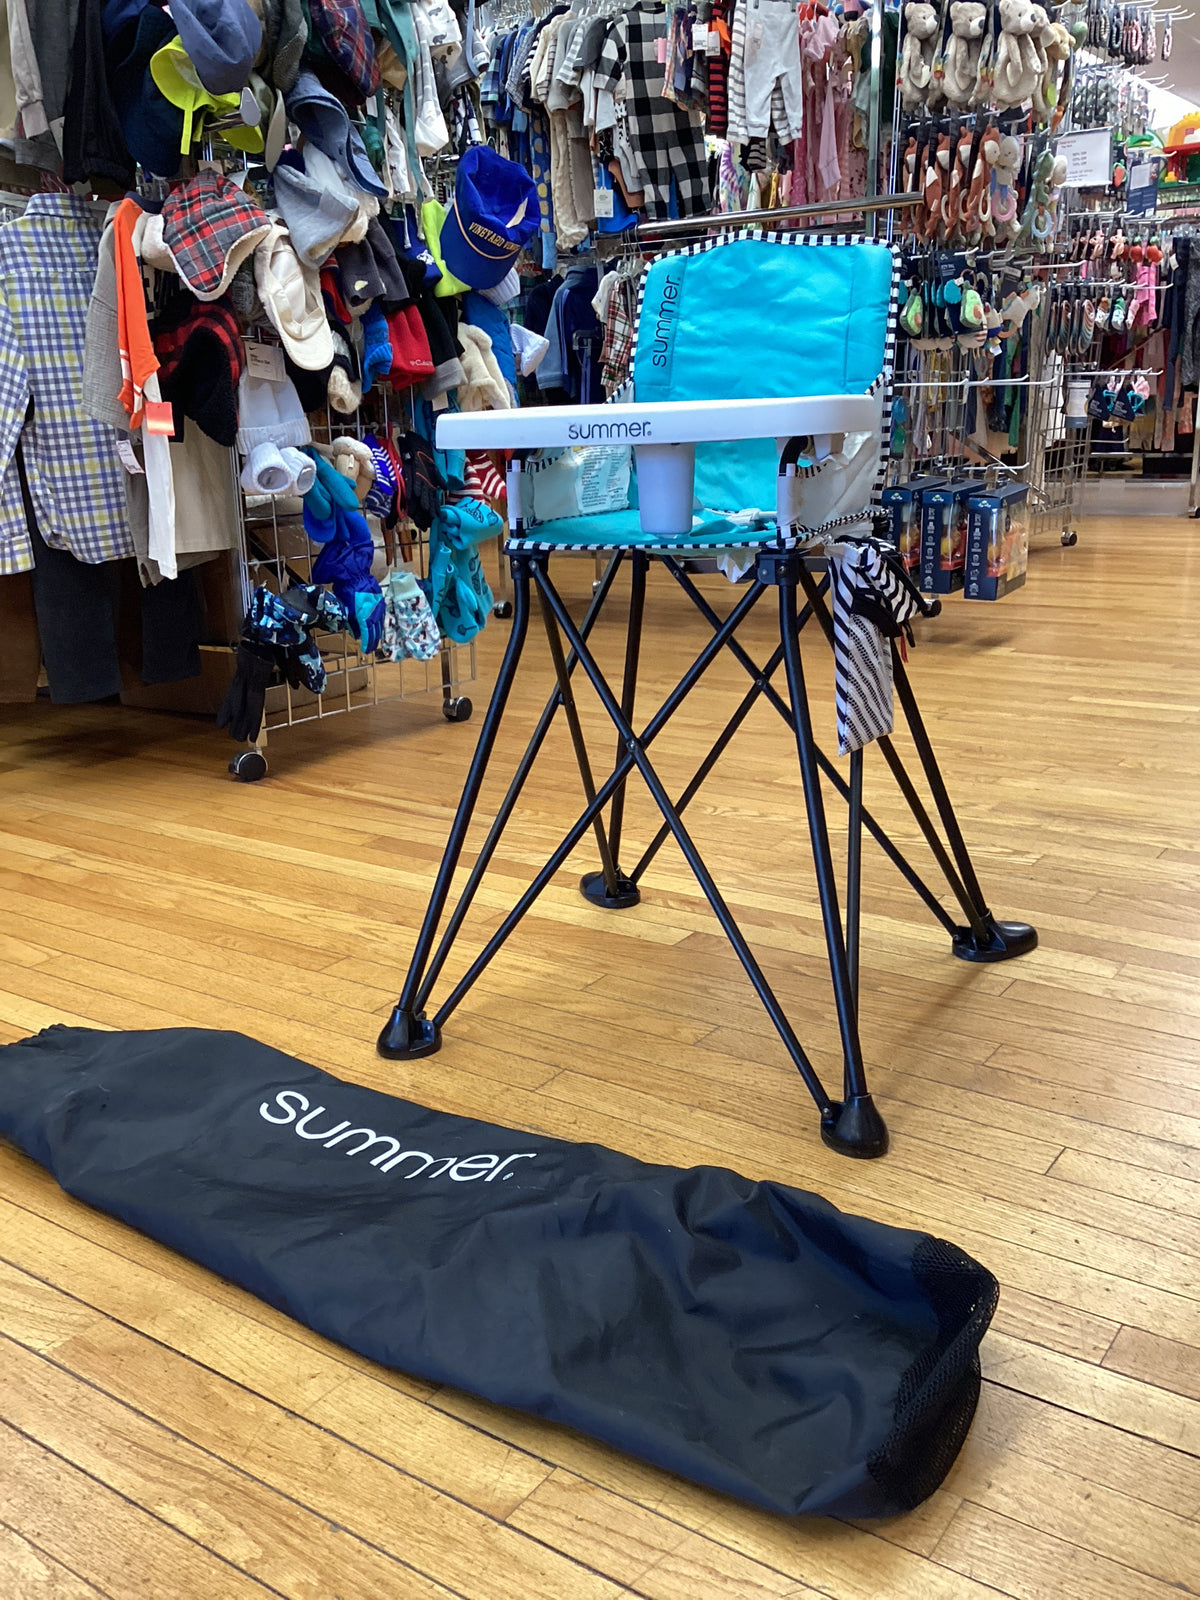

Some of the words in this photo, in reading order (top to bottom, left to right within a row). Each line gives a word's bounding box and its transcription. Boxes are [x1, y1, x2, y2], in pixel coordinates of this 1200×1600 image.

[468, 221, 505, 247] VINEYARD
[568, 421, 651, 440] summer
[259, 1090, 536, 1182] summer
